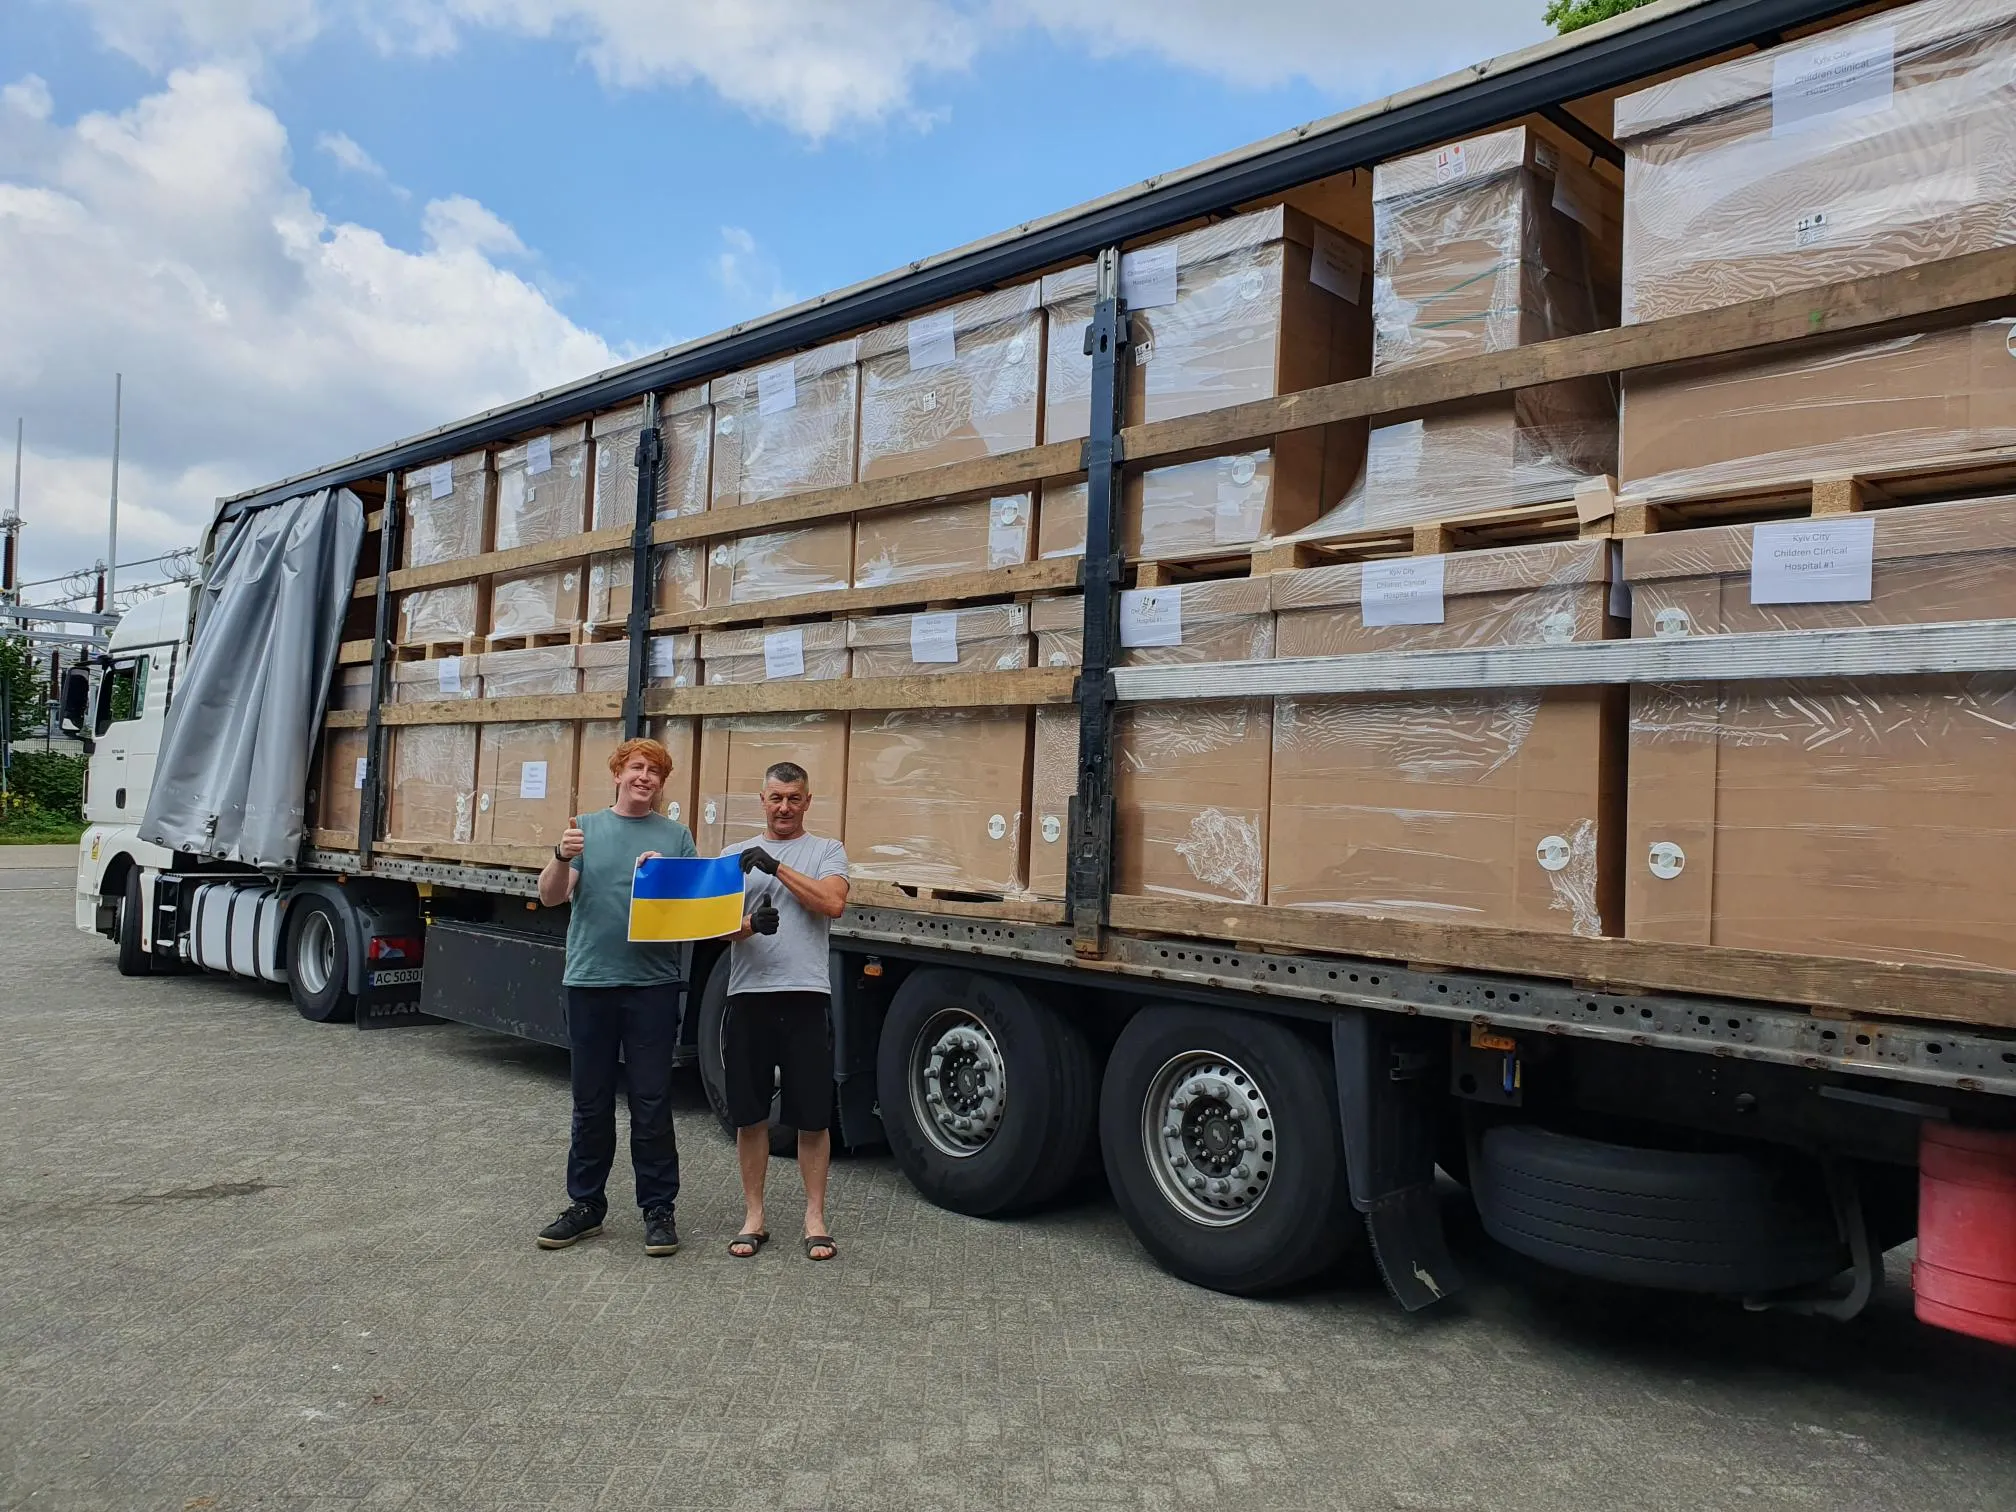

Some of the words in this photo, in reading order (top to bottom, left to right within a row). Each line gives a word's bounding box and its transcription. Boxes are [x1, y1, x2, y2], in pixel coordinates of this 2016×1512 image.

[1794, 71, 1832, 85] Children
[1834, 59, 1870, 74] Clinical
[1792, 535, 1810, 543] Kyiv
[1812, 534, 1831, 542] City
[1774, 549, 1811, 558] Children
[1813, 547, 1848, 556] Clinical
[1784, 562, 1821, 571] Hospital
[1823, 561, 1835, 569] #1
